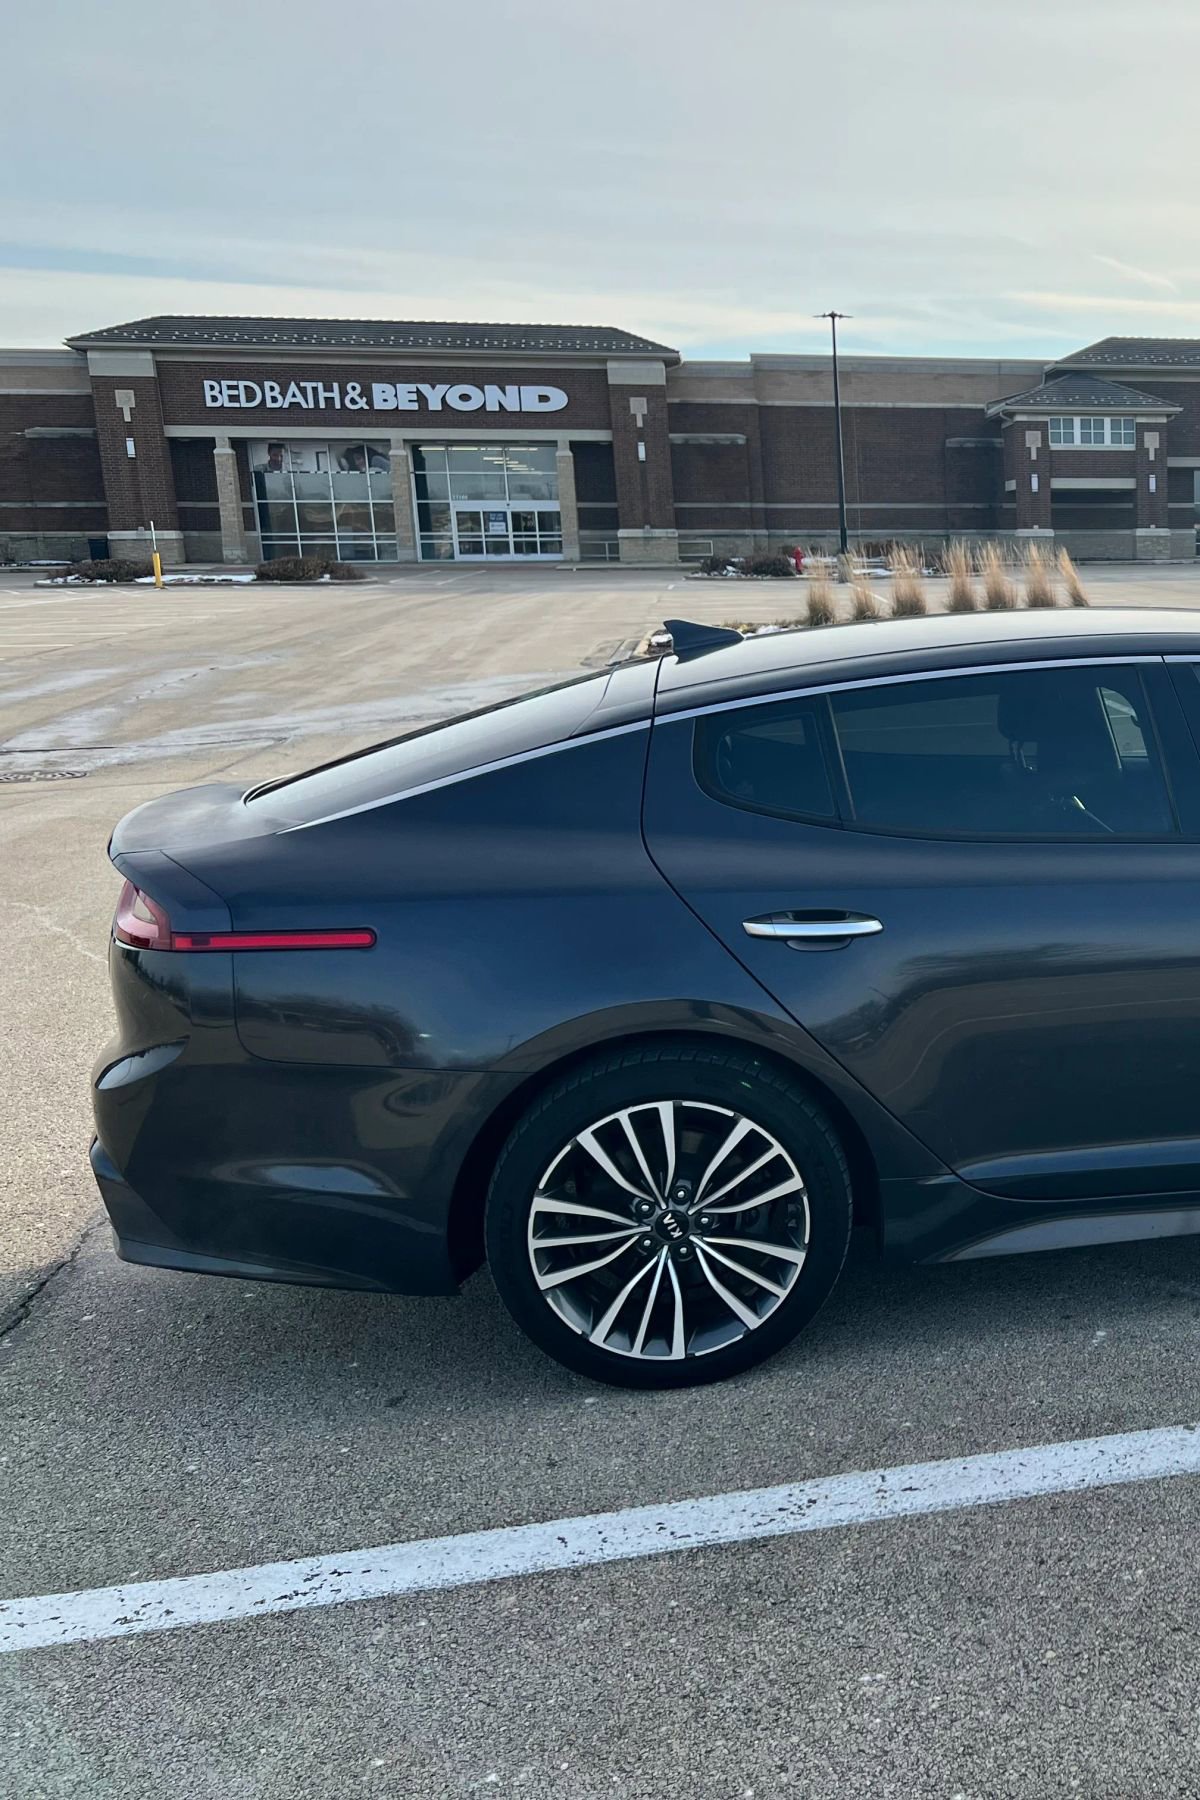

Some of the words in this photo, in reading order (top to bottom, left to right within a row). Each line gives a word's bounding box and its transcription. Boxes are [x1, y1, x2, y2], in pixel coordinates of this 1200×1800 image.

[203, 380, 262, 408] BED
[264, 381, 341, 409] BATH
[344, 382, 369, 410] &
[371, 383, 569, 412] BEYOND
[663, 1212, 683, 1238] KIA
